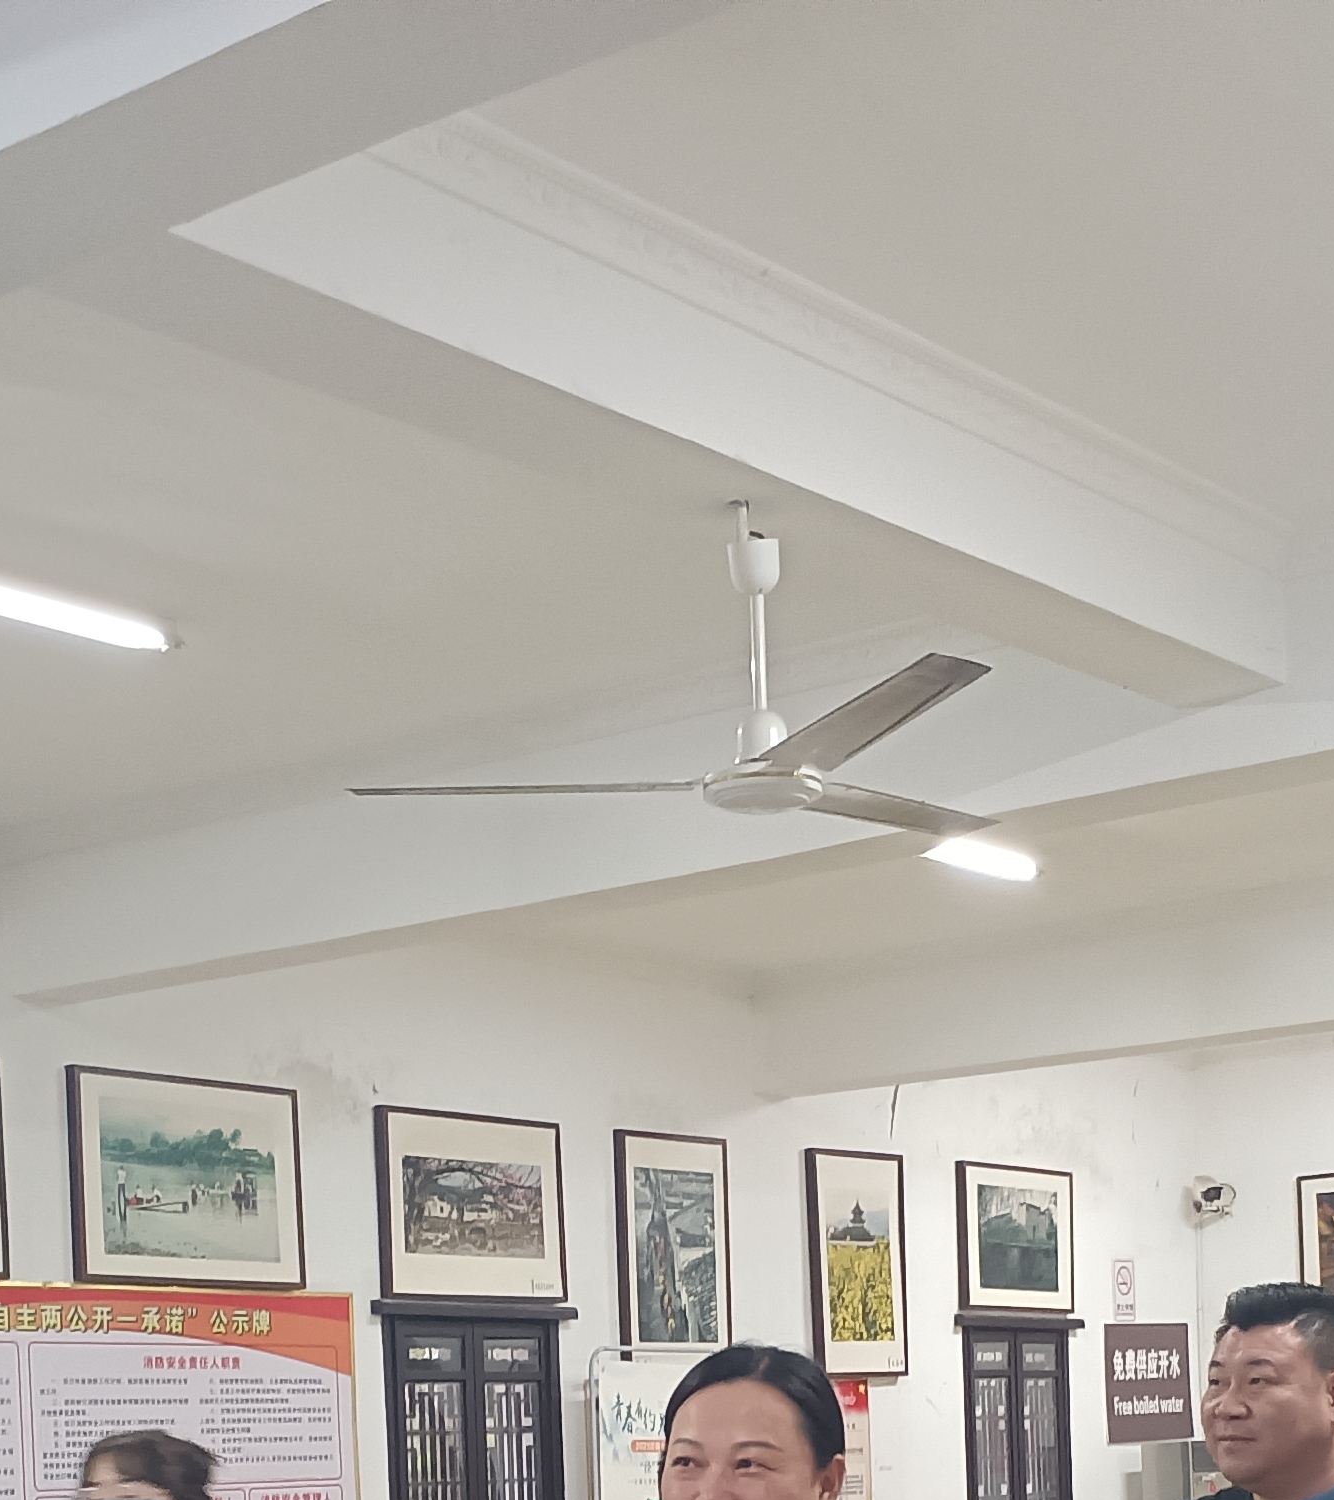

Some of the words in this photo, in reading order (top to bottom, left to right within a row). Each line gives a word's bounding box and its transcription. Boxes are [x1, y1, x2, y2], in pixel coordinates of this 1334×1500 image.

[210, 1309, 272, 1336] 公示牌
[1113, 1348, 1181, 1381] 免费供应开水
[1134, 1395, 1159, 1415] boiled
